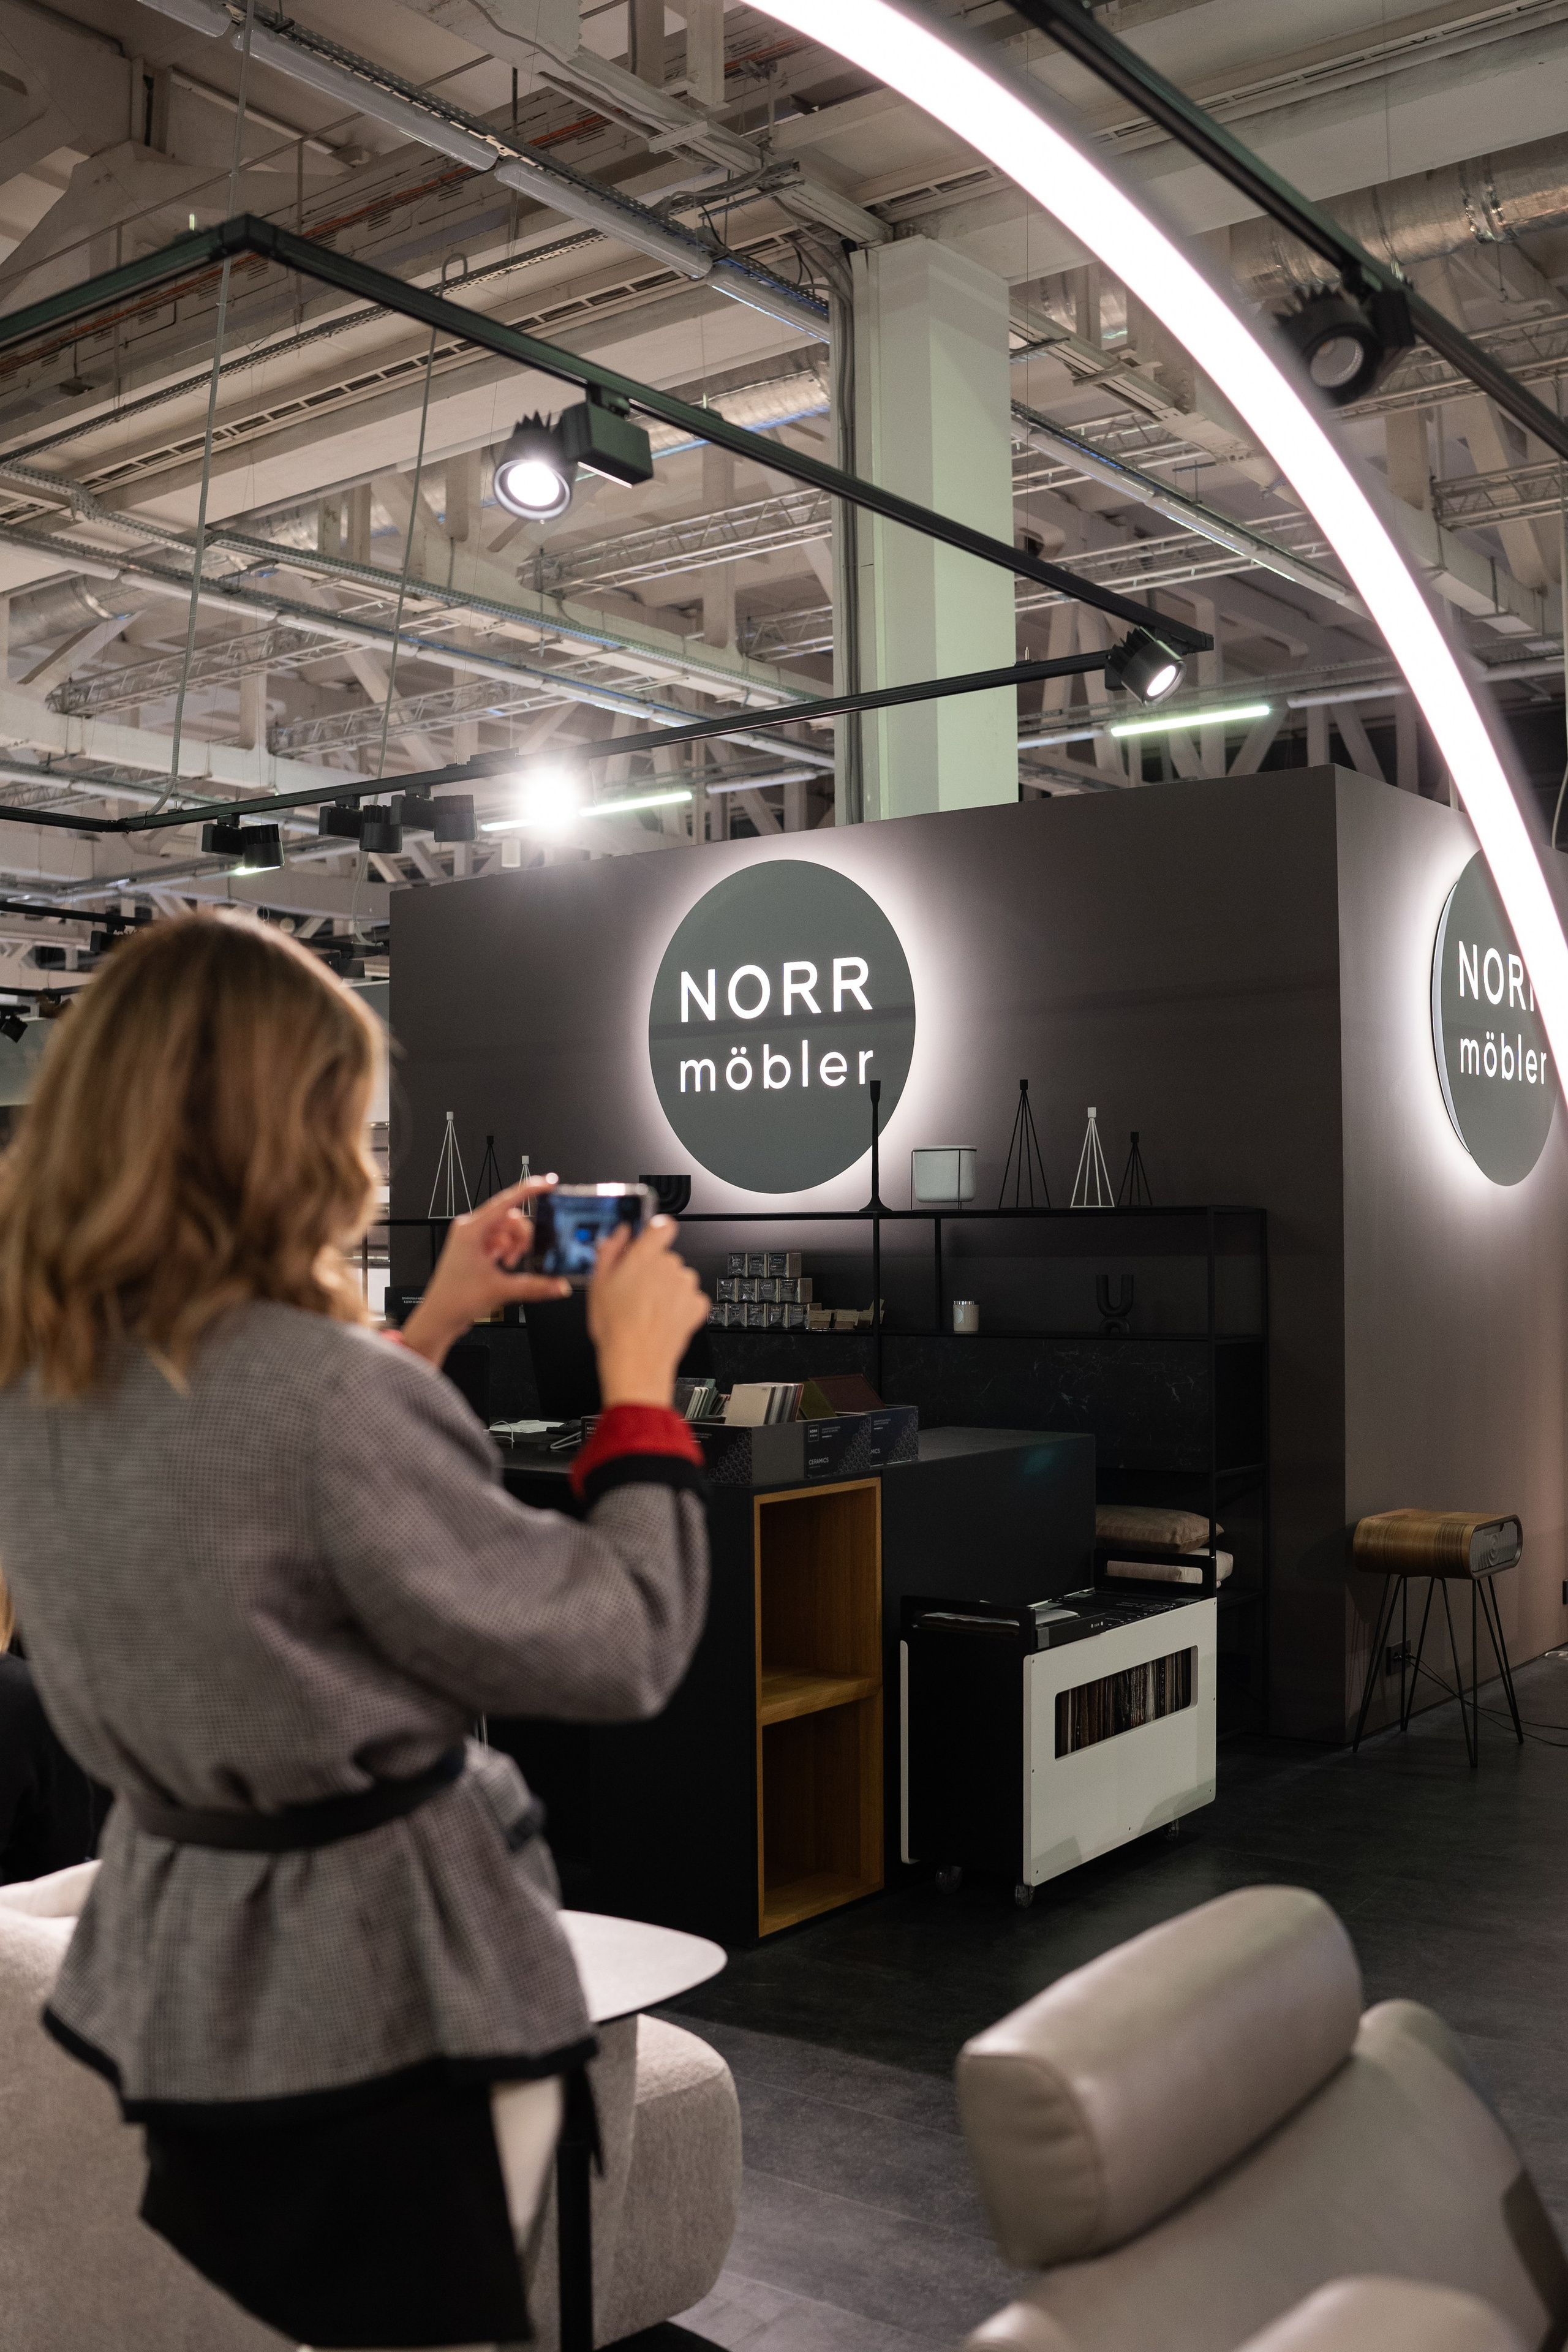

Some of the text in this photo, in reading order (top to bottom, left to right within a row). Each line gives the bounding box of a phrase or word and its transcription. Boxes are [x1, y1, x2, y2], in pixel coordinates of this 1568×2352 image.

[680, 956, 873, 1023] NORR
[679, 1039, 873, 1093] möbler
[1460, 1031, 1547, 1085] möbler
[809, 1457, 829, 1465] CERAMICS
